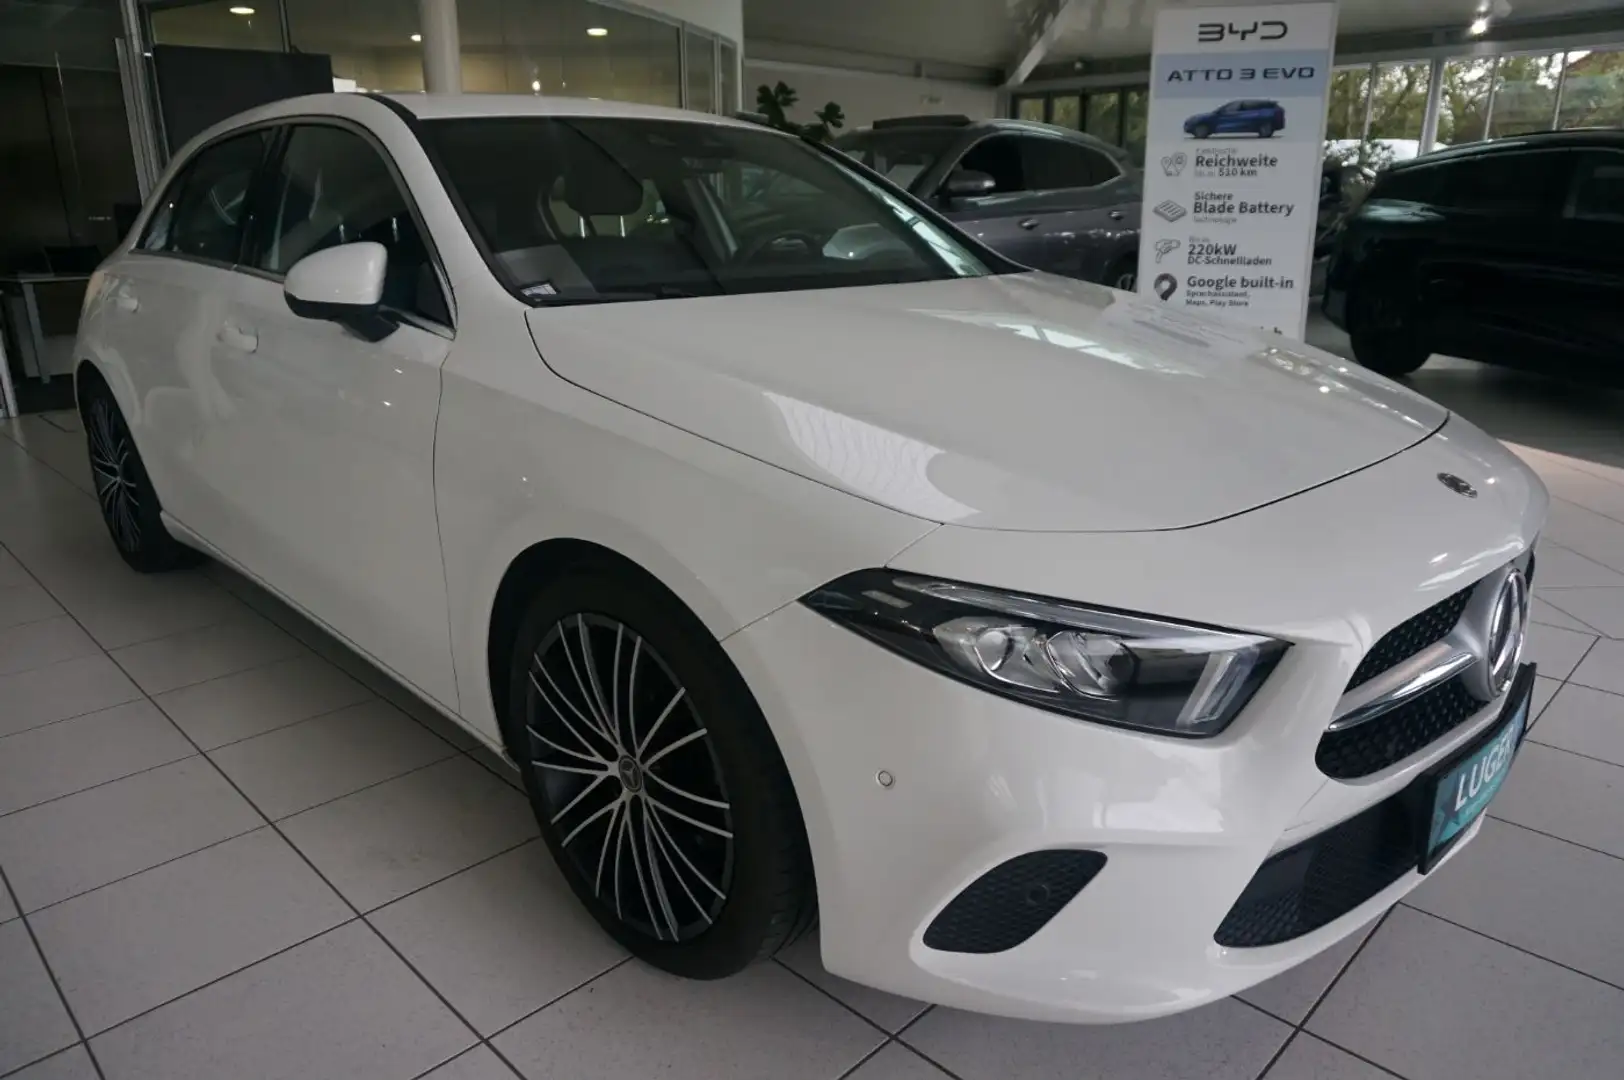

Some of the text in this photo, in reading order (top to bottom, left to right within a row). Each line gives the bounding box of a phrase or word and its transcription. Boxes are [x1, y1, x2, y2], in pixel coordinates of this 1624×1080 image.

[1198, 20, 1287, 42] BYD
[1167, 66, 1316, 83] ATTO 3 EVO
[1195, 153, 1279, 168] Reichweite
[1239, 167, 1258, 177] km
[1194, 191, 1234, 201] Sichere
[1193, 200, 1295, 217] Blade Battery
[1187, 242, 1237, 256] 220kW
[1187, 255, 1273, 266] DC-Schnellladen
[1187, 275, 1295, 291] Google built-in
